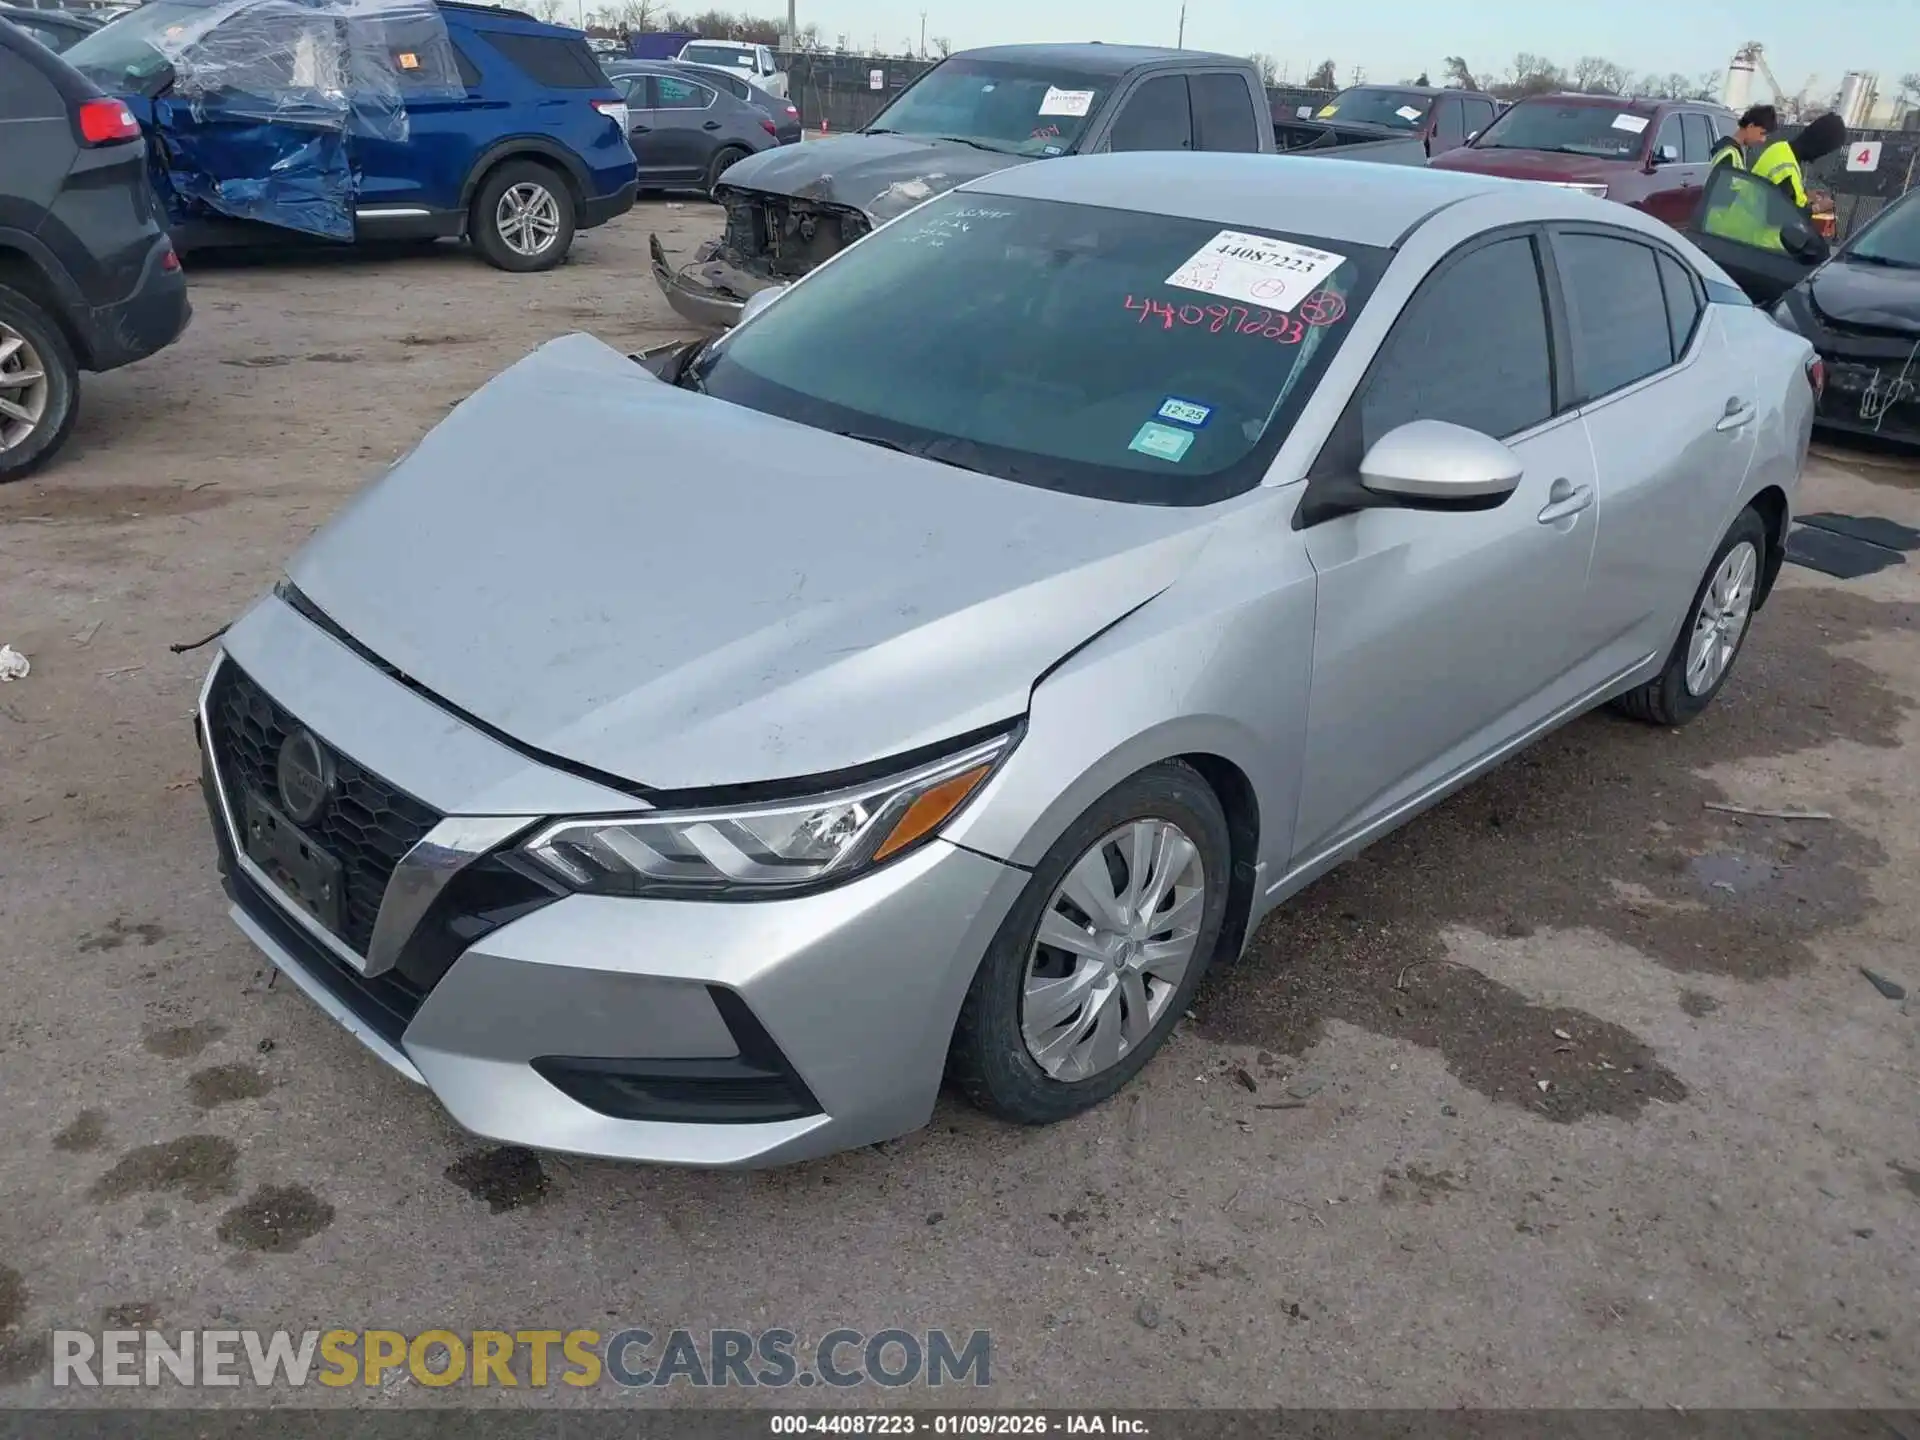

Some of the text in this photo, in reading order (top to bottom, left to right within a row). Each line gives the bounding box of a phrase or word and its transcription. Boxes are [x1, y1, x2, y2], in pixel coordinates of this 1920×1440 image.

[1855, 149, 1870, 165] 4
[1215, 243, 1316, 273] 44087223
[1124, 294, 1304, 344] 44087223
